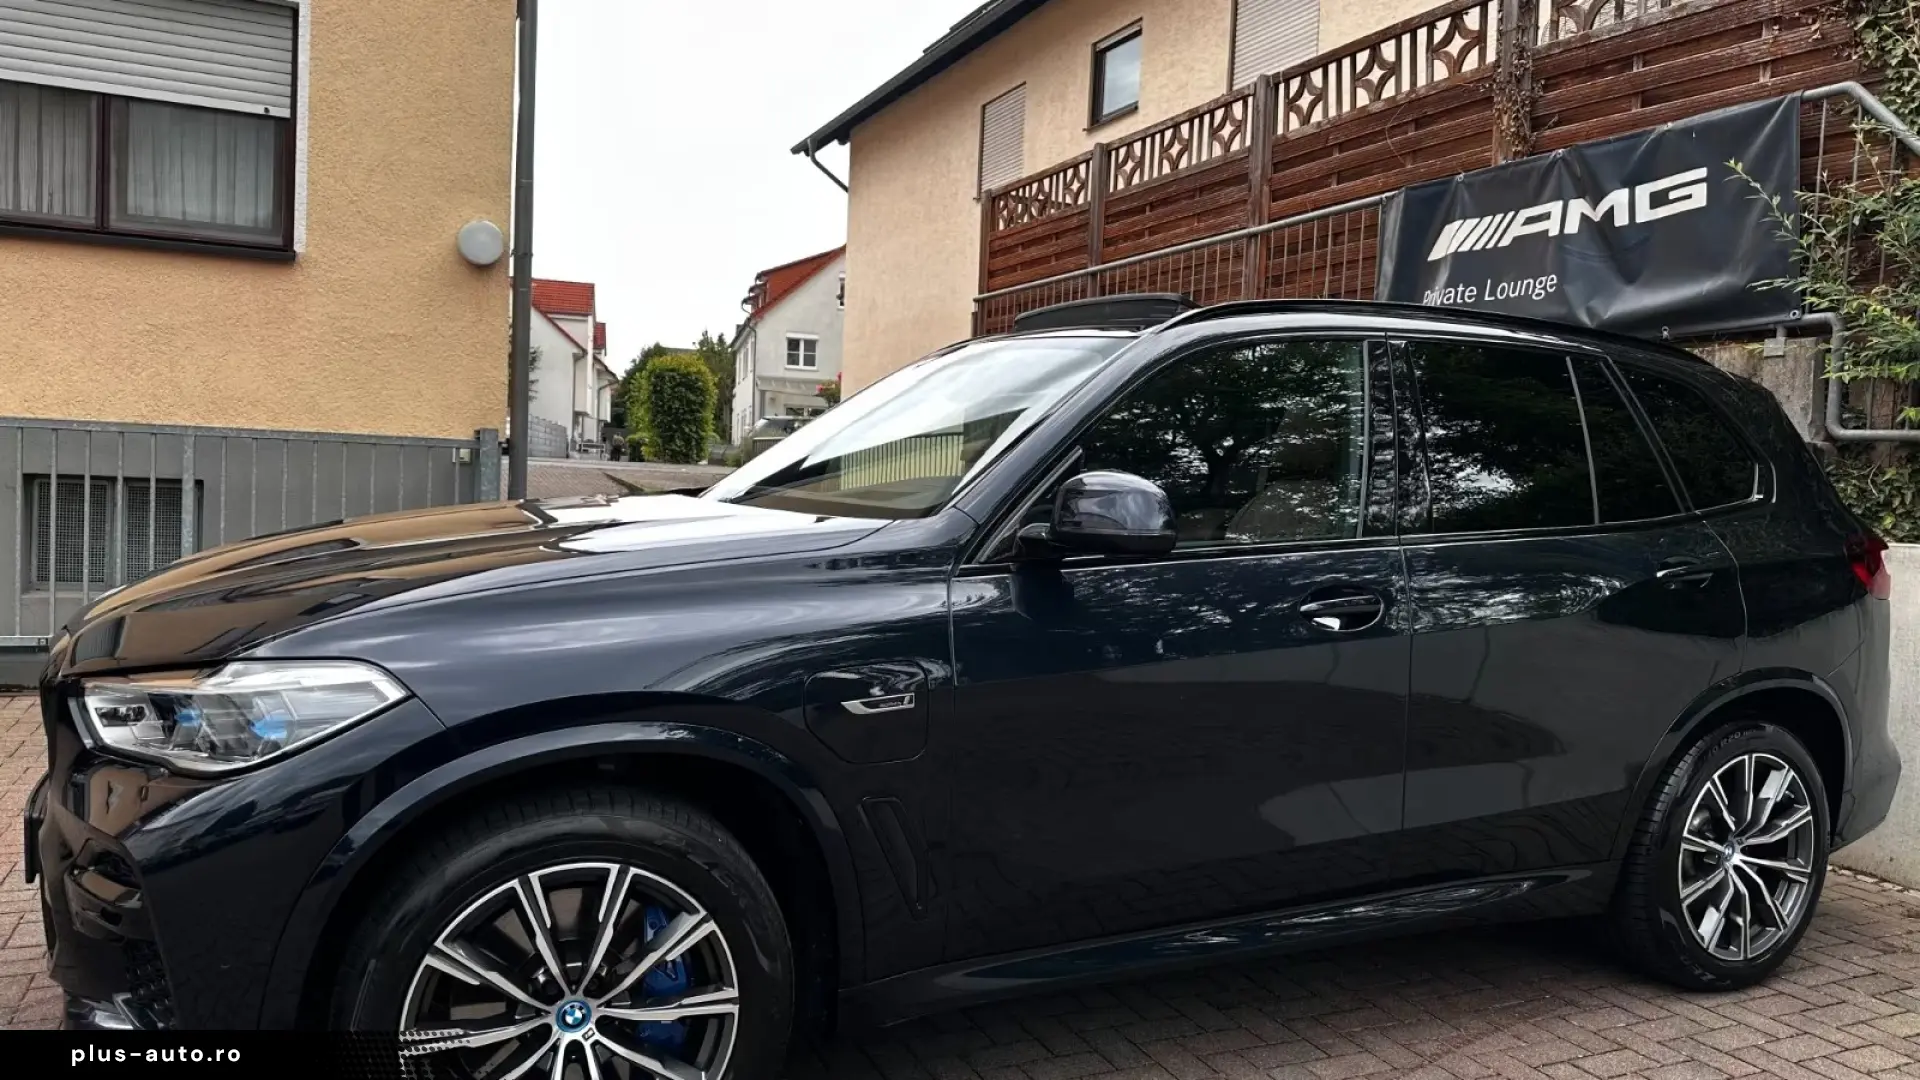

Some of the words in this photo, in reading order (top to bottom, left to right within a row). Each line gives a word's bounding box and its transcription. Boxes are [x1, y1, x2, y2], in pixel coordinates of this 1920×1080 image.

[1498, 166, 1708, 248] AMG
[1422, 283, 1477, 307] Private
[1484, 274, 1557, 301] Lounge
